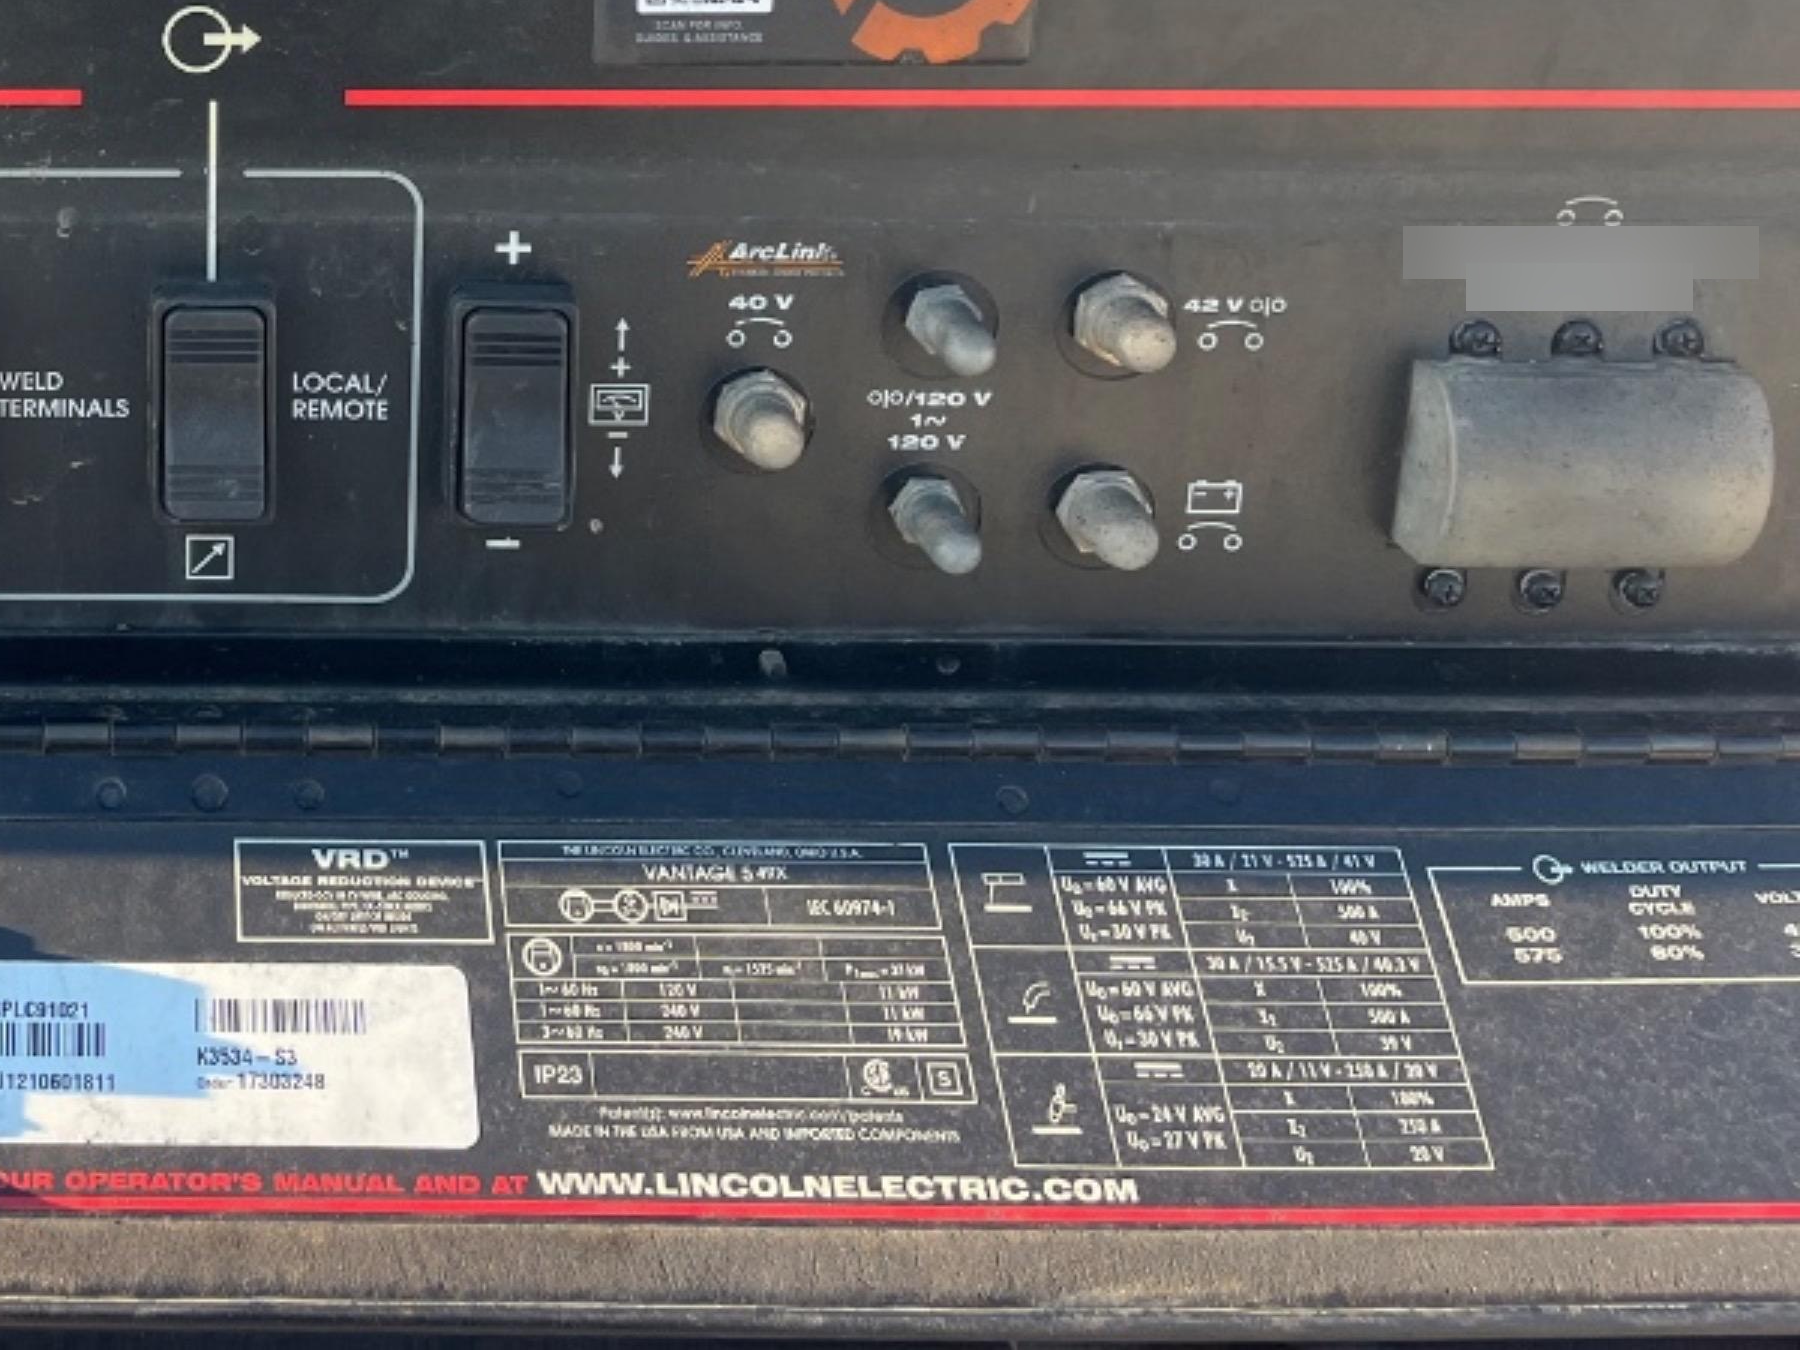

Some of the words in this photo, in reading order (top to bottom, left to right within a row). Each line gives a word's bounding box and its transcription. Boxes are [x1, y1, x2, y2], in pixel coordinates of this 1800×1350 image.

[728, 293, 768, 311] 40
[774, 293, 795, 311] V
[1184, 298, 1220, 313] 42
[1226, 298, 1244, 313] V
[292, 371, 388, 397] LOCAL/
[291, 398, 388, 420] REMOTE
[887, 434, 940, 450] 120
[946, 434, 967, 450] V
[641, 863, 737, 882] VANTAGE
[1580, 860, 1665, 875] WELDER
[1669, 859, 1747, 875] OUTPUT
[241, 874, 312, 888] VOLTAGE
[317, 874, 411, 888] REDUCTION
[1629, 885, 1682, 898] DUTY
[1490, 893, 1550, 908] AMPS
[1628, 902, 1696, 916] CYCLE
[1637, 924, 1703, 941] 100%
[533, 1065, 583, 1085] IP23
[64, 1171, 263, 1193] OPERATOR'S
[274, 1173, 406, 1194] MANUAL
[414, 1173, 481, 1194] AND
[491, 1174, 527, 1195] AT
[537, 1171, 1140, 1206] WWW.LINCOLNELECTRIC.COM
